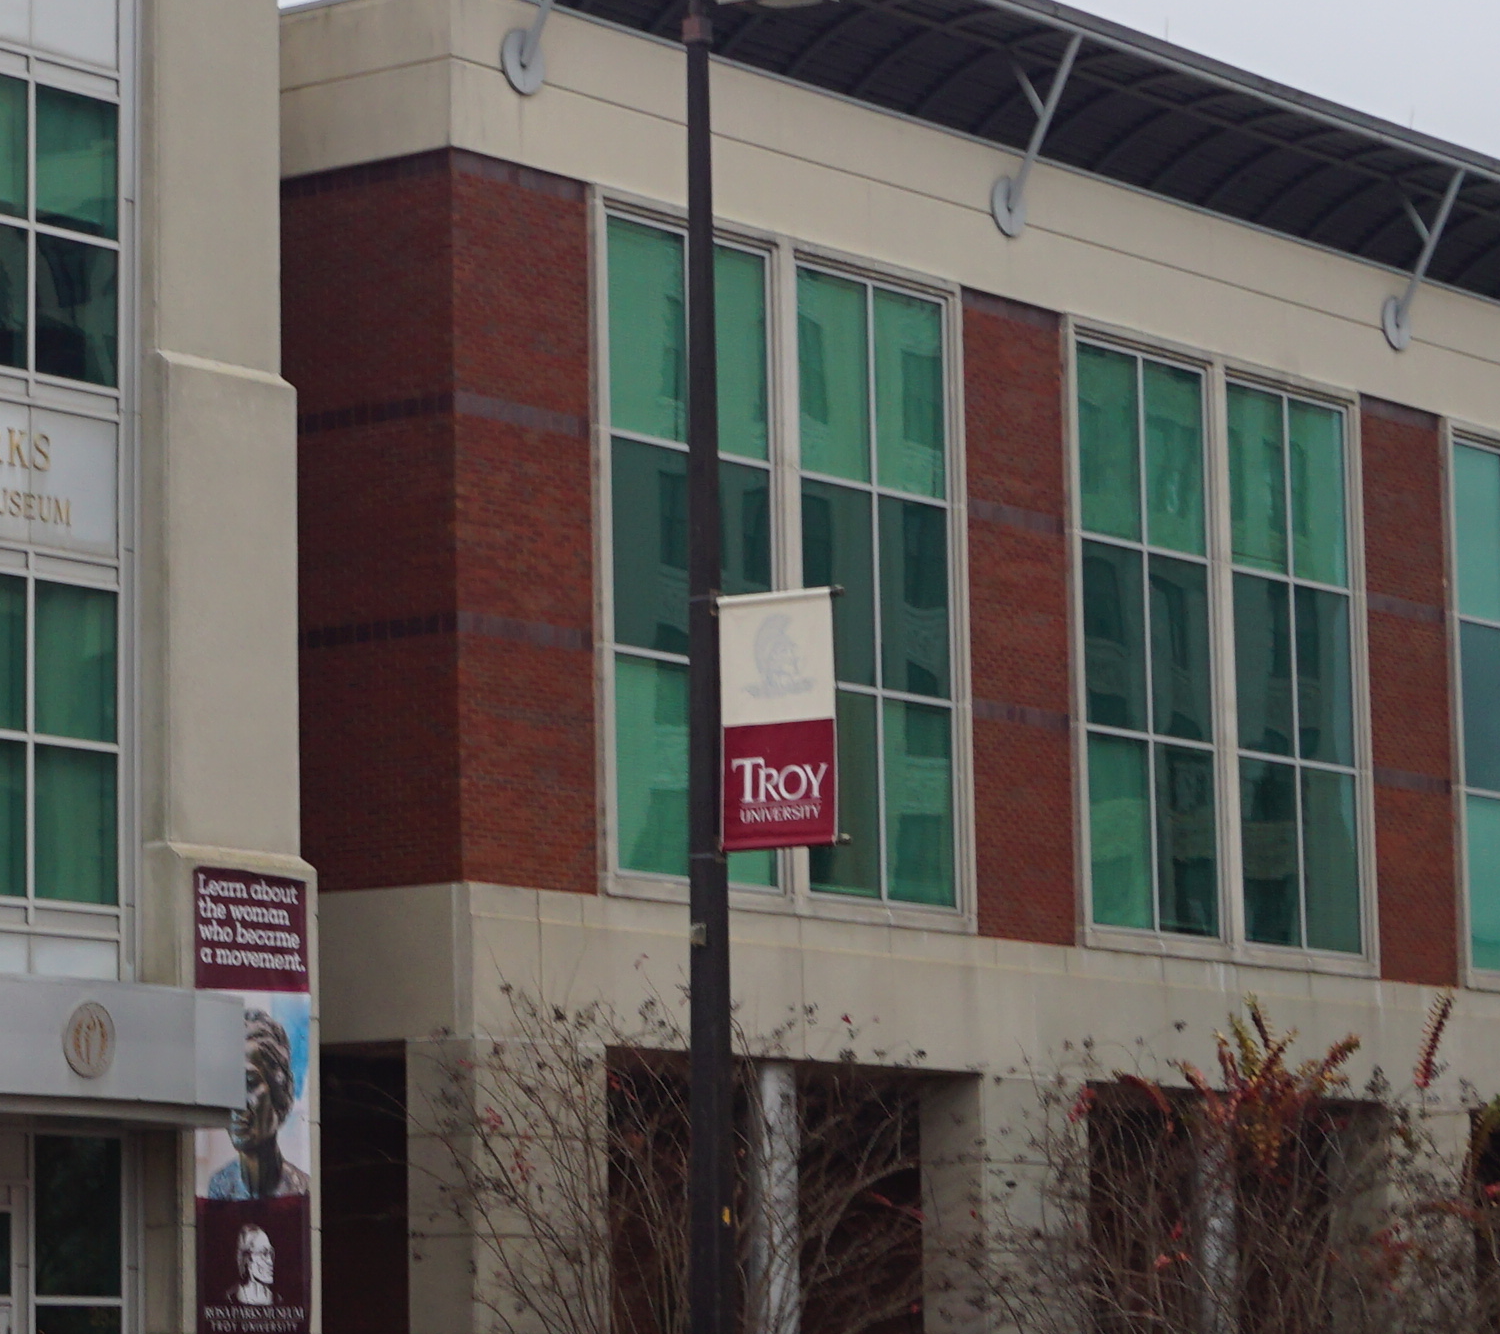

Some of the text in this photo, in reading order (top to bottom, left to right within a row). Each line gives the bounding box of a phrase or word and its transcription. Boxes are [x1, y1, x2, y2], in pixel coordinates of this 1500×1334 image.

[731, 756, 829, 804] TROY
[739, 803, 822, 824] UNIVERSITY
[197, 872, 298, 905] Learn about
[197, 895, 291, 926] the woman
[198, 919, 301, 949] who became
[200, 947, 306, 972] a movement.
[210, 1320, 297, 1333] TROY UNIVERSITY
